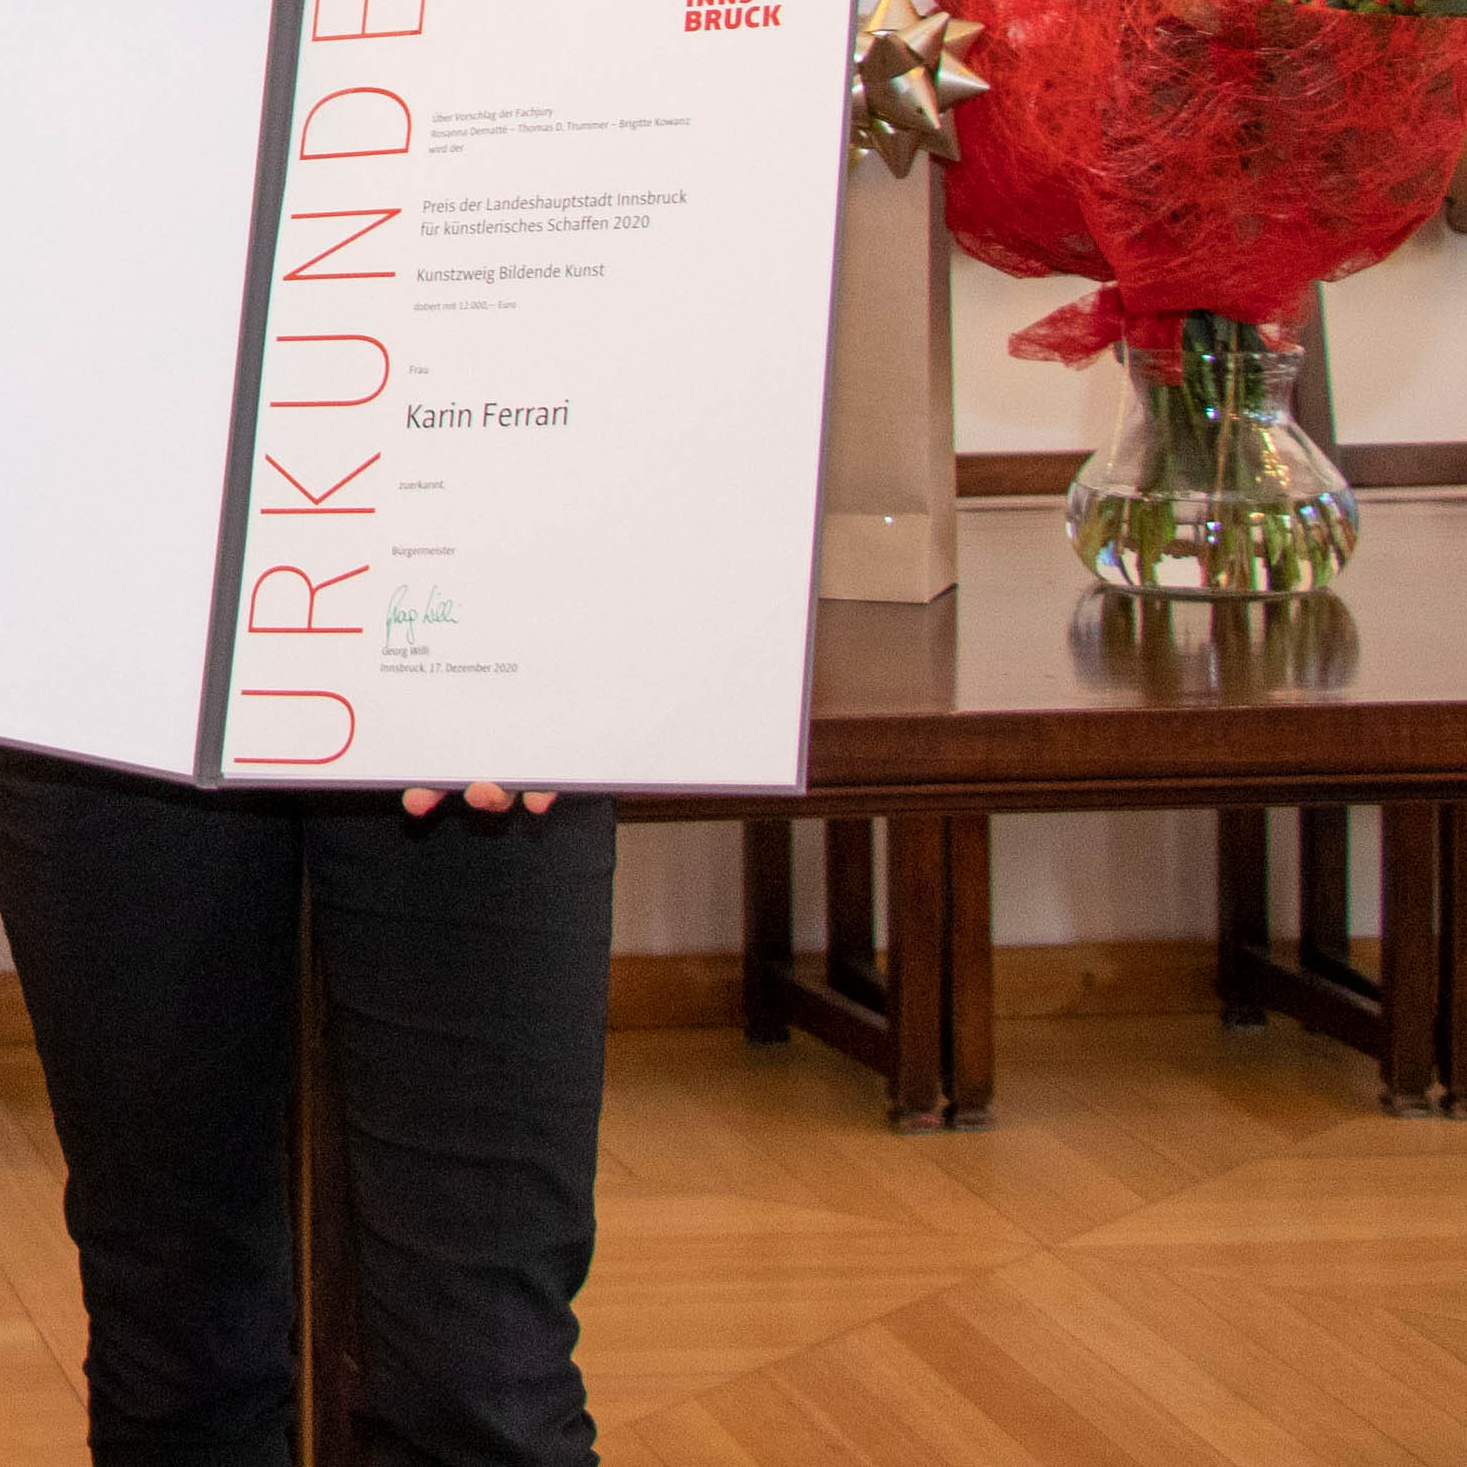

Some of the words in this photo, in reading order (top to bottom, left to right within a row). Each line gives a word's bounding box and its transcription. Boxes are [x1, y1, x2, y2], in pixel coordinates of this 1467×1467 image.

[684, 4, 782, 32] BRUCK
[455, 109, 496, 122] Vorschlag
[499, 109, 513, 119] der
[515, 107, 553, 120] Fachjury
[518, 122, 553, 133] Thomas
[567, 120, 609, 131] Trummer
[619, 118, 652, 131] Brigitte
[654, 117, 691, 127] Kowanz
[428, 143, 447, 154] wird
[449, 142, 464, 153] der
[422, 198, 455, 214] Preis
[459, 198, 483, 213] der
[485, 192, 613, 213] Landeshauptstadt
[617, 189, 688, 207] Innsbruck
[420, 221, 440, 237] für
[443, 217, 544, 236] künstlerisches
[548, 215, 609, 232] Schaffen
[613, 214, 650, 230] 2020
[416, 266, 495, 284] Kunstzweig
[498, 263, 561, 280] Bildende
[565, 262, 606, 278] Kunst
[408, 365, 429, 375] Frau
[406, 402, 472, 429] Karin
[483, 399, 569, 427] Ferrari
[381, 646, 408, 658] Georg
[410, 645, 429, 656] Willi
[445, 662, 491, 674] Dezember
[494, 662, 518, 674] 2020
